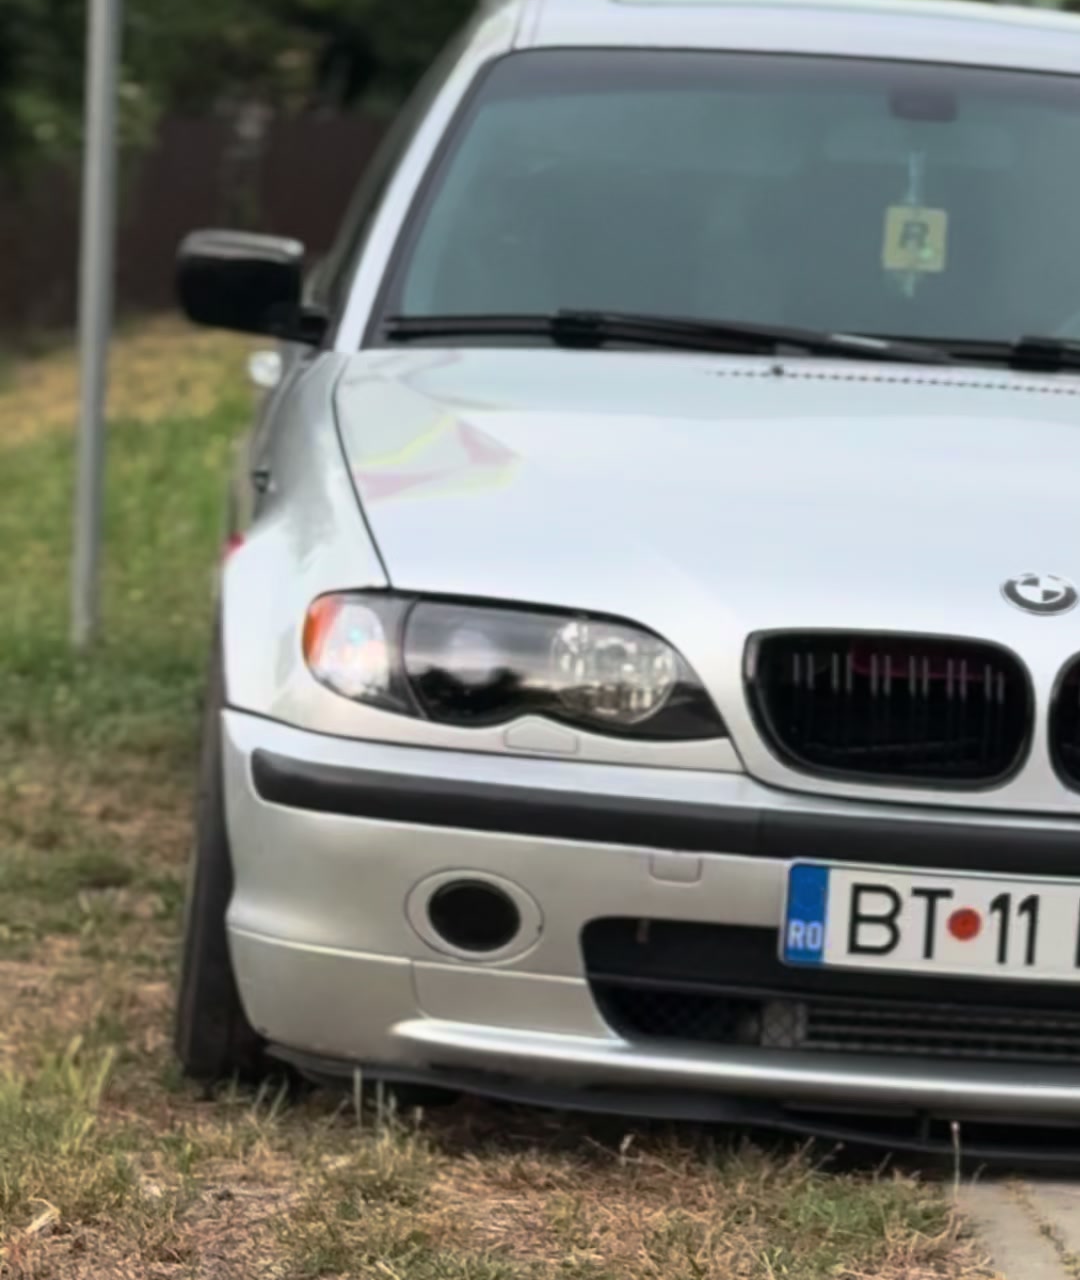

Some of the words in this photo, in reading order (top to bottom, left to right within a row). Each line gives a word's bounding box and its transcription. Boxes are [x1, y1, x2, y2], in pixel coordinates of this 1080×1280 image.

[786, 919, 824, 951] RO
[847, 882, 954, 959] BT
[989, 892, 1040, 966] 11
